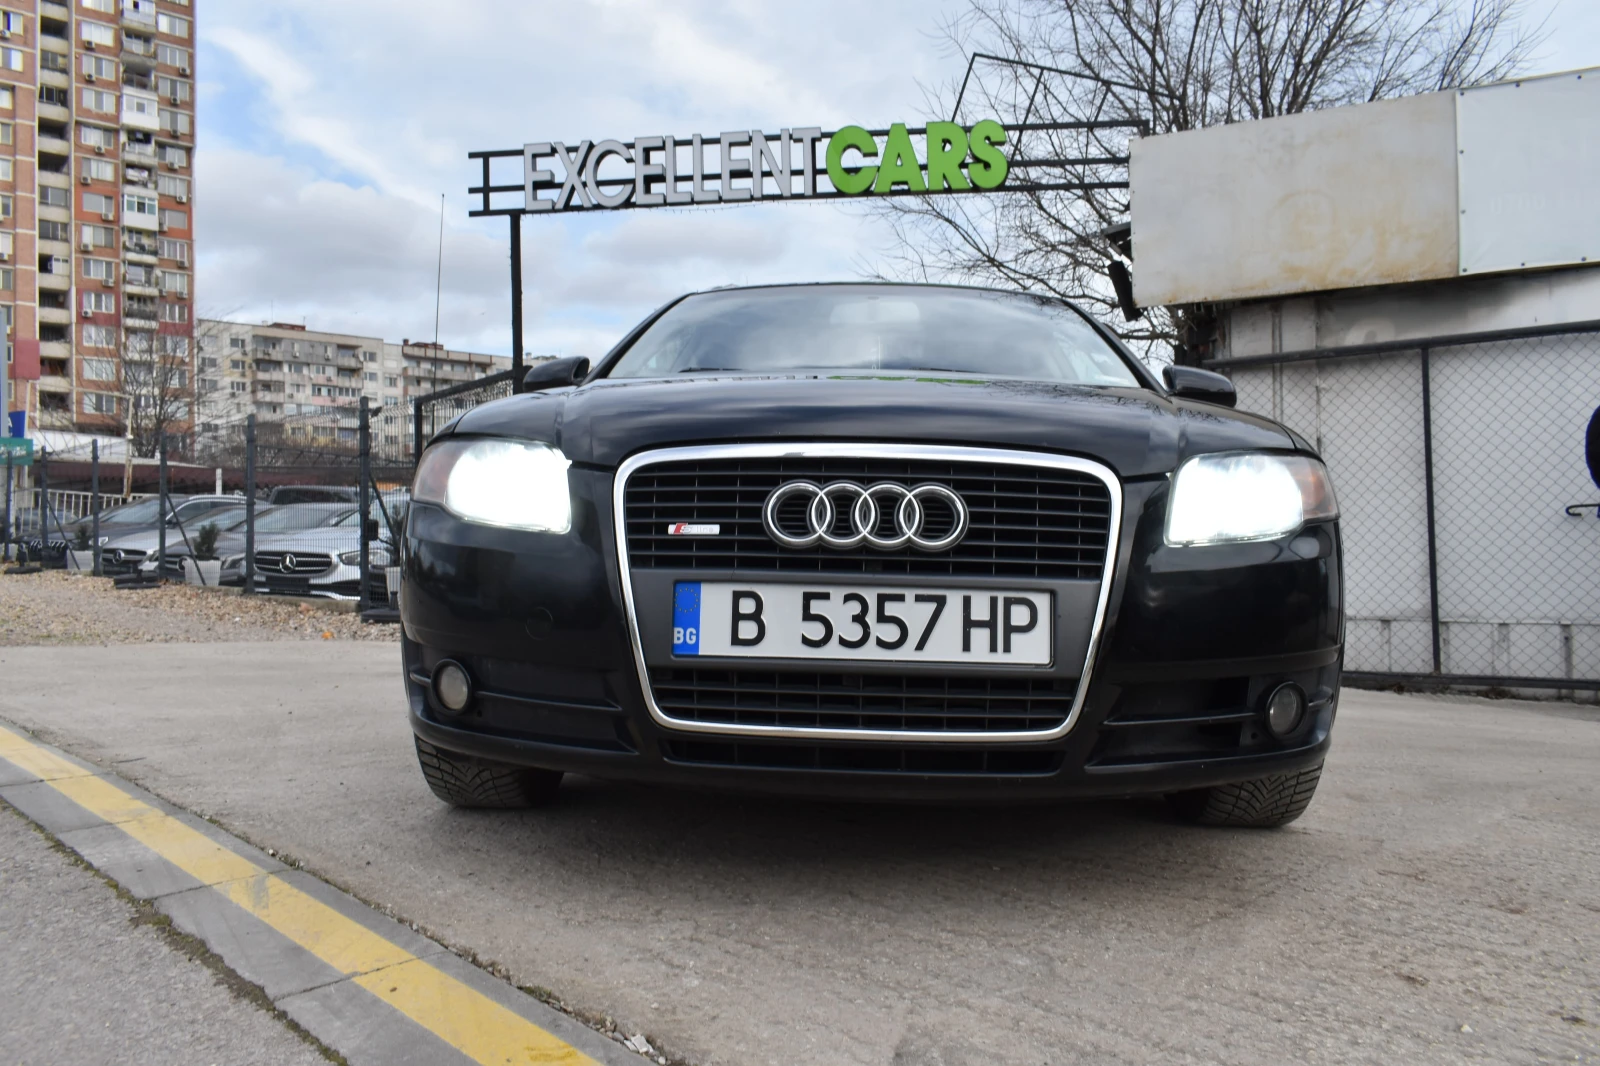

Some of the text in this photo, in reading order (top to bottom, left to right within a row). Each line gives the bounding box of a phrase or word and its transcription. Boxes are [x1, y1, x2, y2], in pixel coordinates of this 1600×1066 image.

[523, 119, 1009, 211] EXCELLENT CARS
[673, 626, 697, 645] BG
[730, 589, 1039, 653] B 5357 HP
